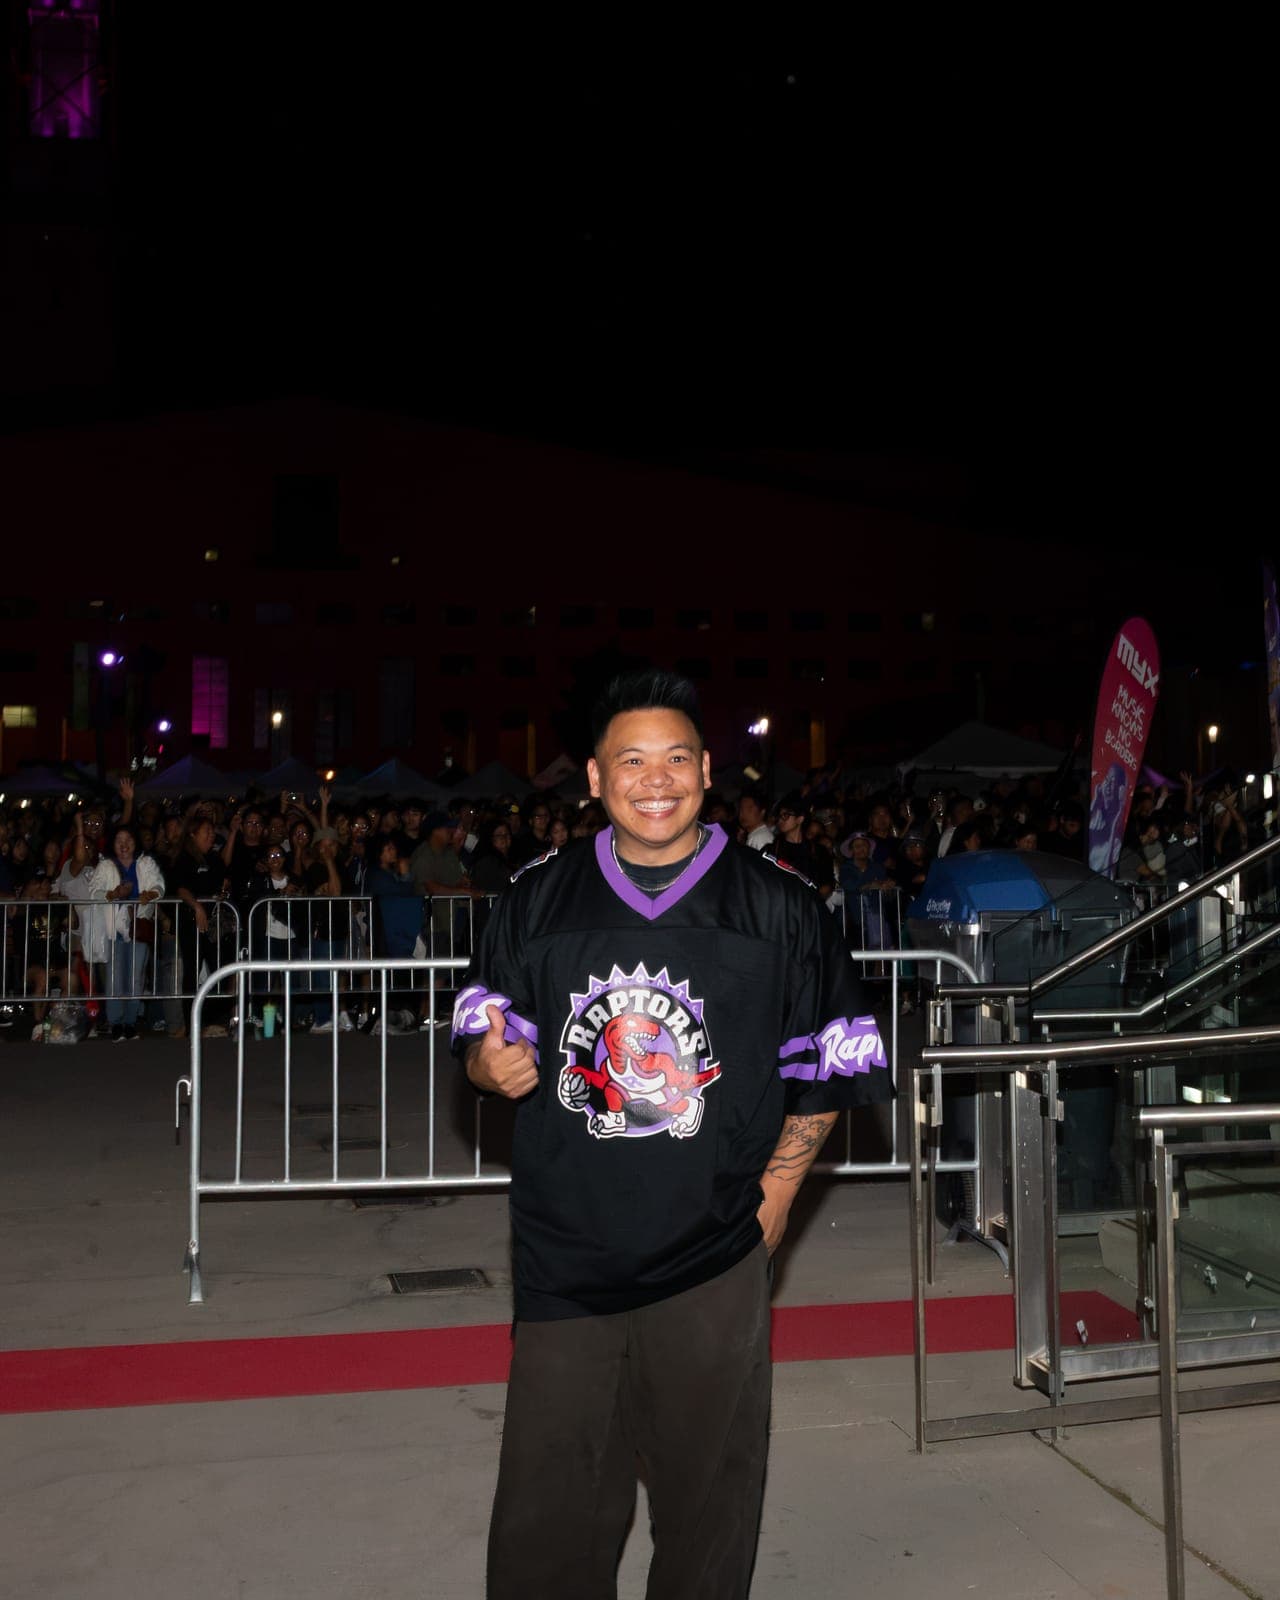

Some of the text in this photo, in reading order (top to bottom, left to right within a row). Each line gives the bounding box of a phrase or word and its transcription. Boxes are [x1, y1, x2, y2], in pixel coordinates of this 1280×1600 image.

[1111, 699, 1143, 742] KNOWS
[1117, 684, 1145, 726] MUSIC
[1104, 728, 1137, 771] BORDERS
[1118, 725, 1131, 747] NO
[576, 975, 699, 1014] TORONTO
[567, 988, 707, 1057] RAPTORS
